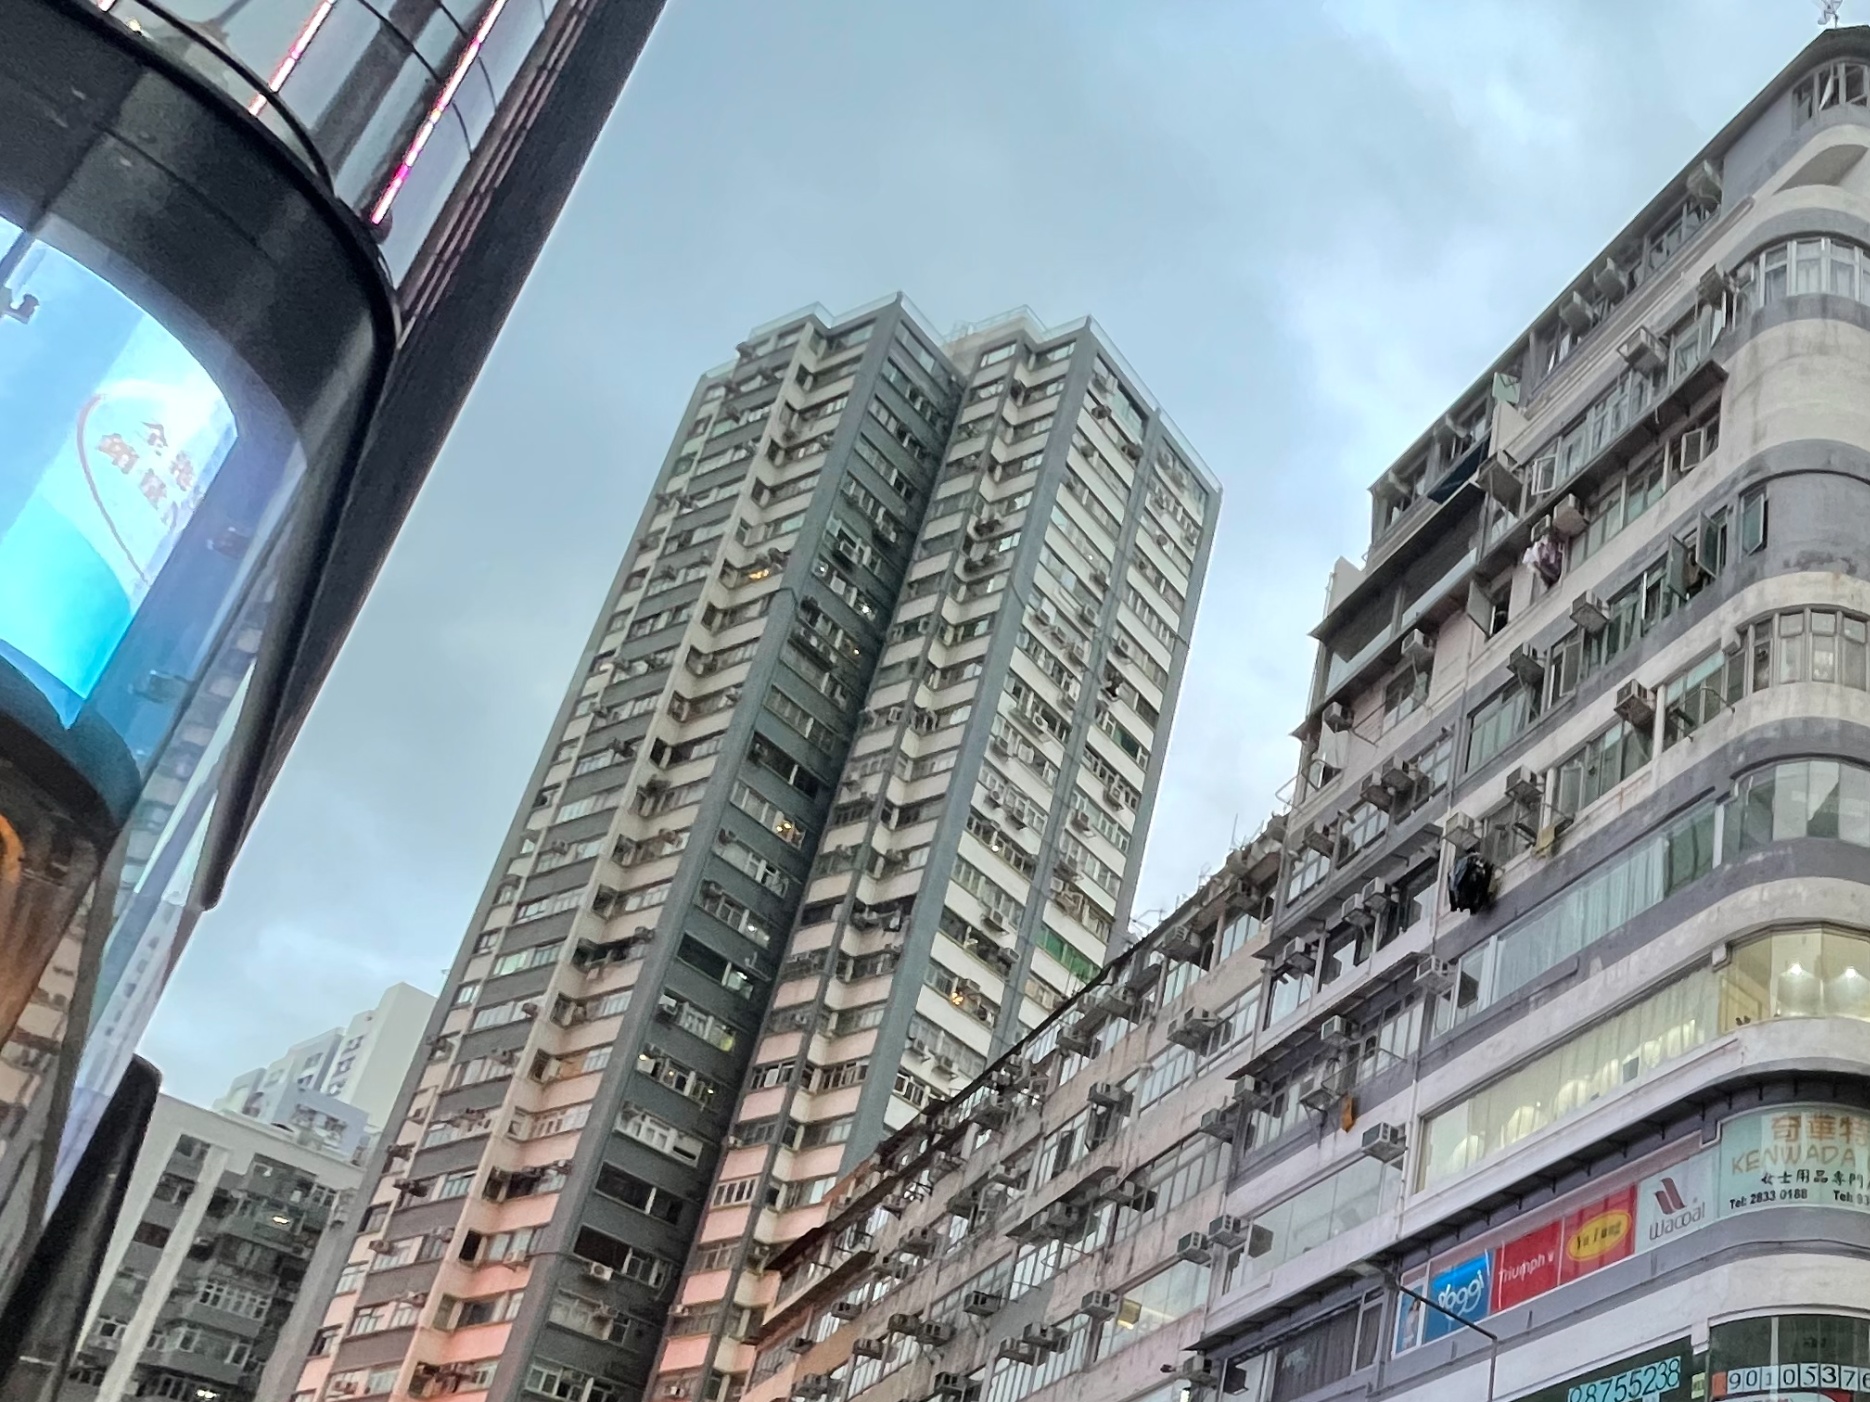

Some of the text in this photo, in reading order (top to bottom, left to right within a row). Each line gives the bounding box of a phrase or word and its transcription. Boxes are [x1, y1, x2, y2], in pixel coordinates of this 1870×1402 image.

[1731, 1144, 1857, 1176] KENWADA
[1729, 1195, 1747, 1210] Tel:
[1750, 1189, 1776, 1205] 2833
[1648, 1201, 1706, 1242] Wacoal
